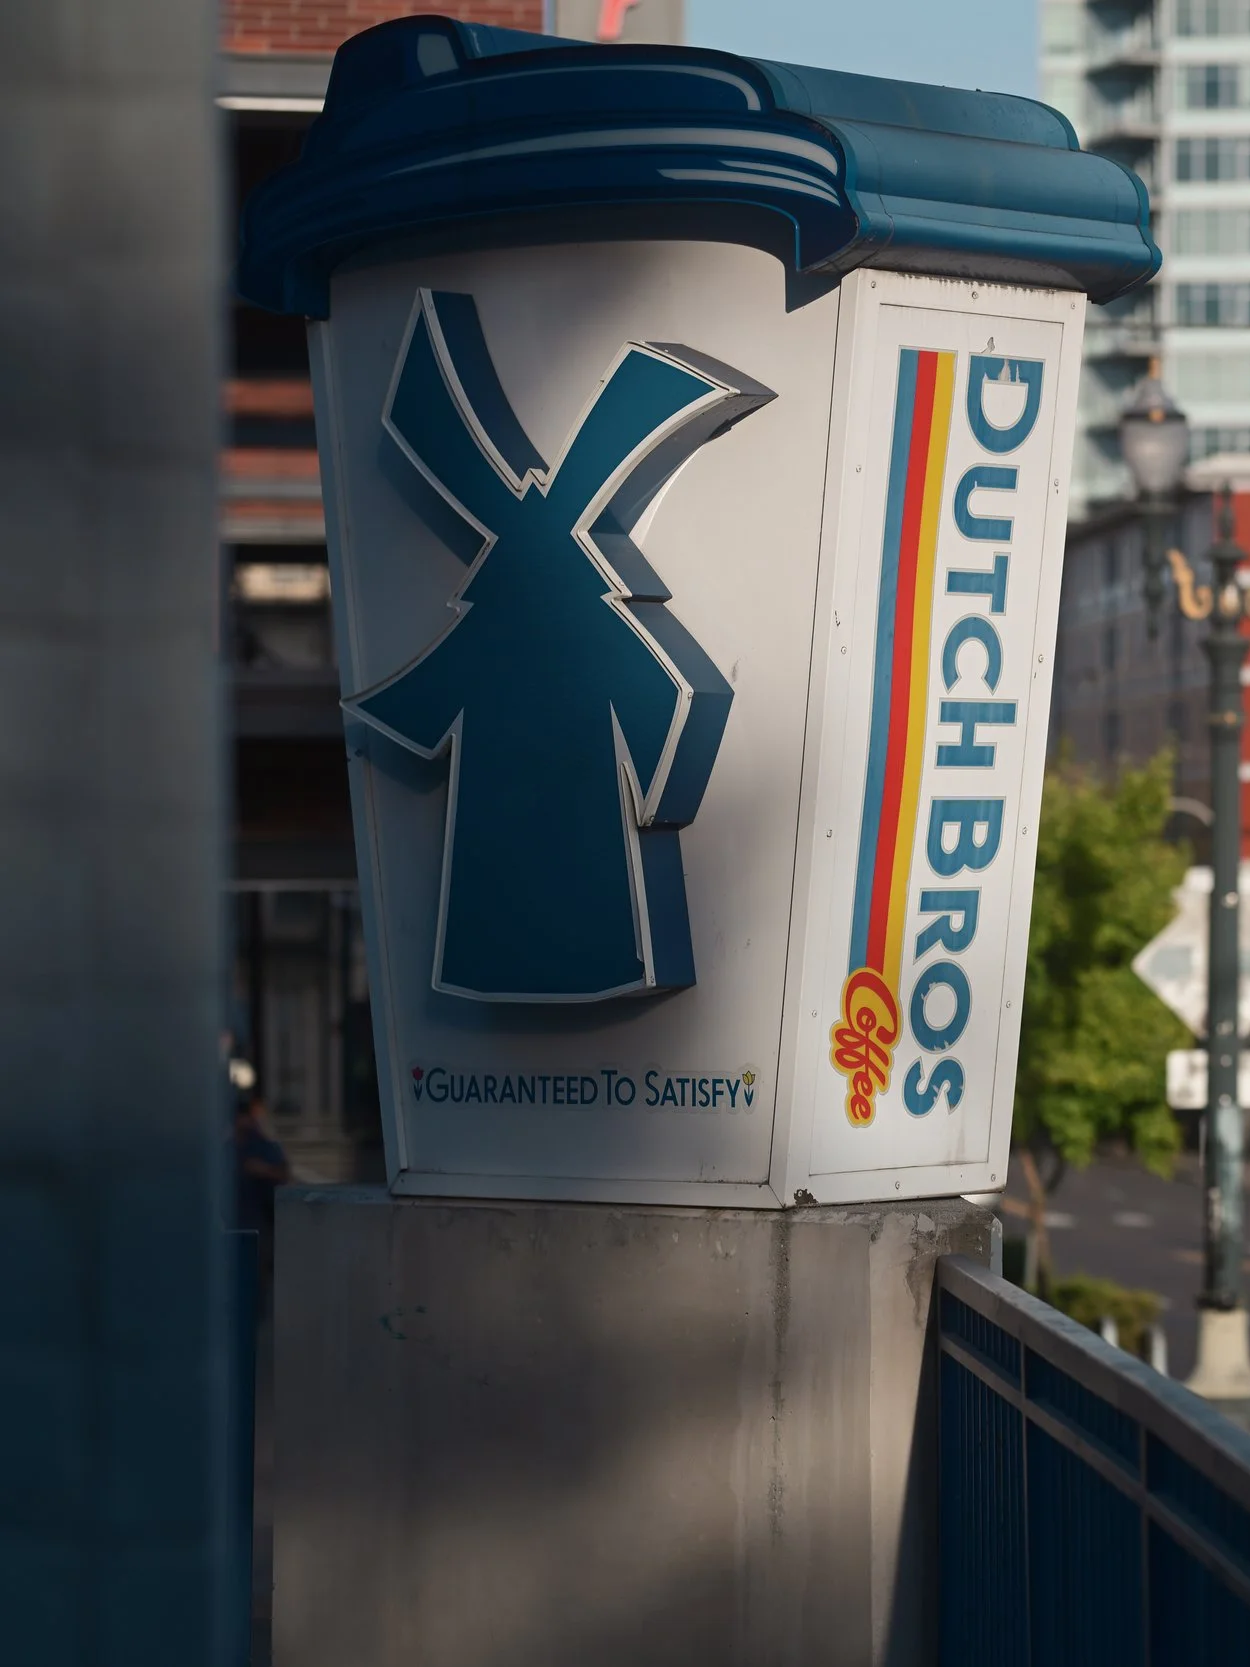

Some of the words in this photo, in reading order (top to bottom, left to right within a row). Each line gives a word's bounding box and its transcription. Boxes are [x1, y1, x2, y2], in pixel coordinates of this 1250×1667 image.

[934, 351, 1042, 769] DUTCH
[834, 971, 898, 1120] Coffee
[903, 796, 1004, 1118] BROS
[425, 1066, 599, 1105] GUARANTEED
[600, 1069, 636, 1106] TO
[644, 1069, 741, 1108] SATISFY
